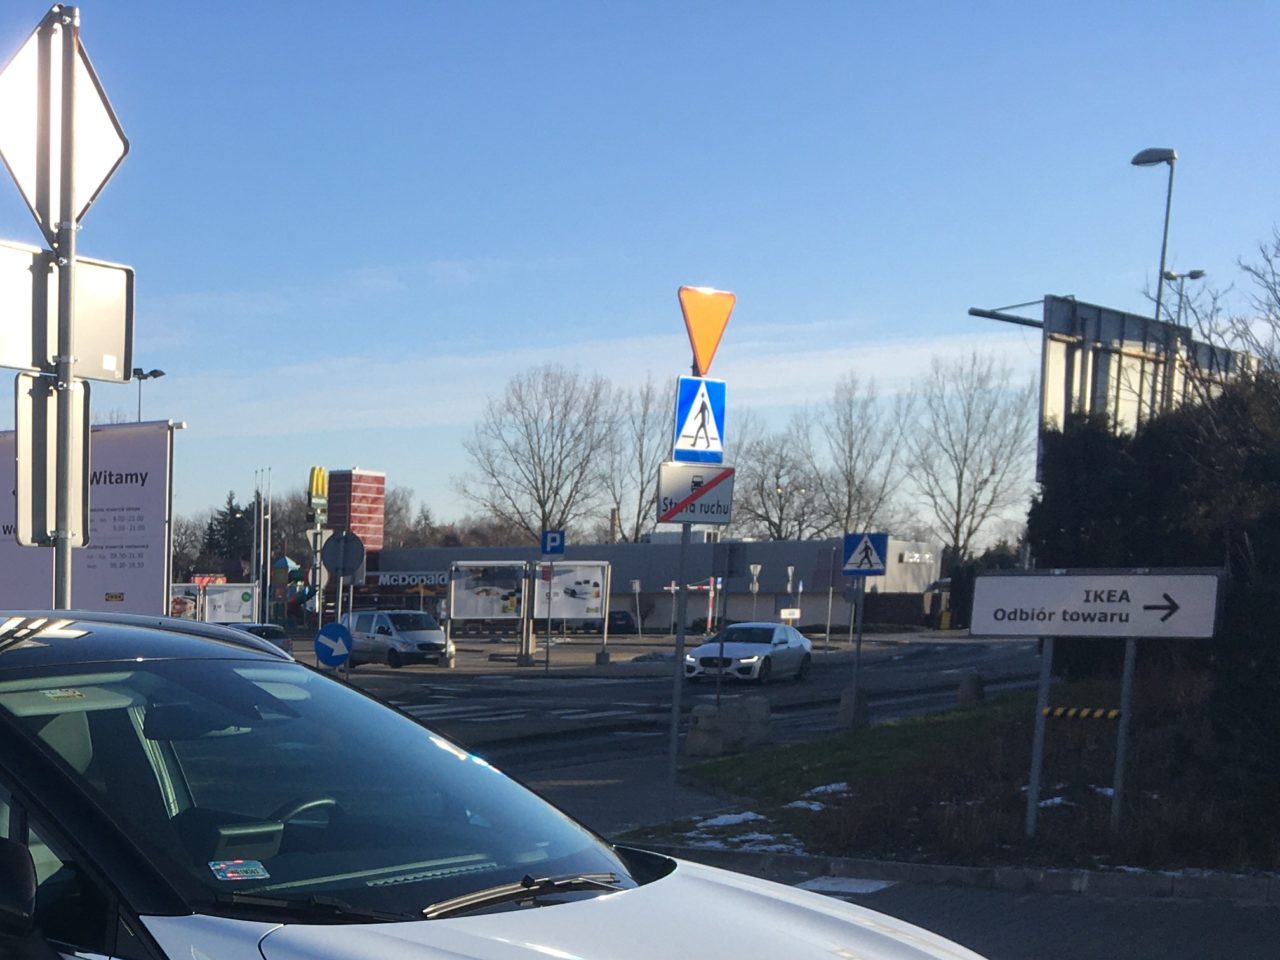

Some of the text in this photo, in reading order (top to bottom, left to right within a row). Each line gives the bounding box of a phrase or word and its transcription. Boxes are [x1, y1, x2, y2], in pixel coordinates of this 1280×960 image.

[90, 470, 149, 487] Witamy
[700, 499, 729, 515] ruchu
[546, 533, 561, 552] P
[1083, 589, 1132, 603] IKEA
[993, 606, 1131, 623] Odbiór towaru
